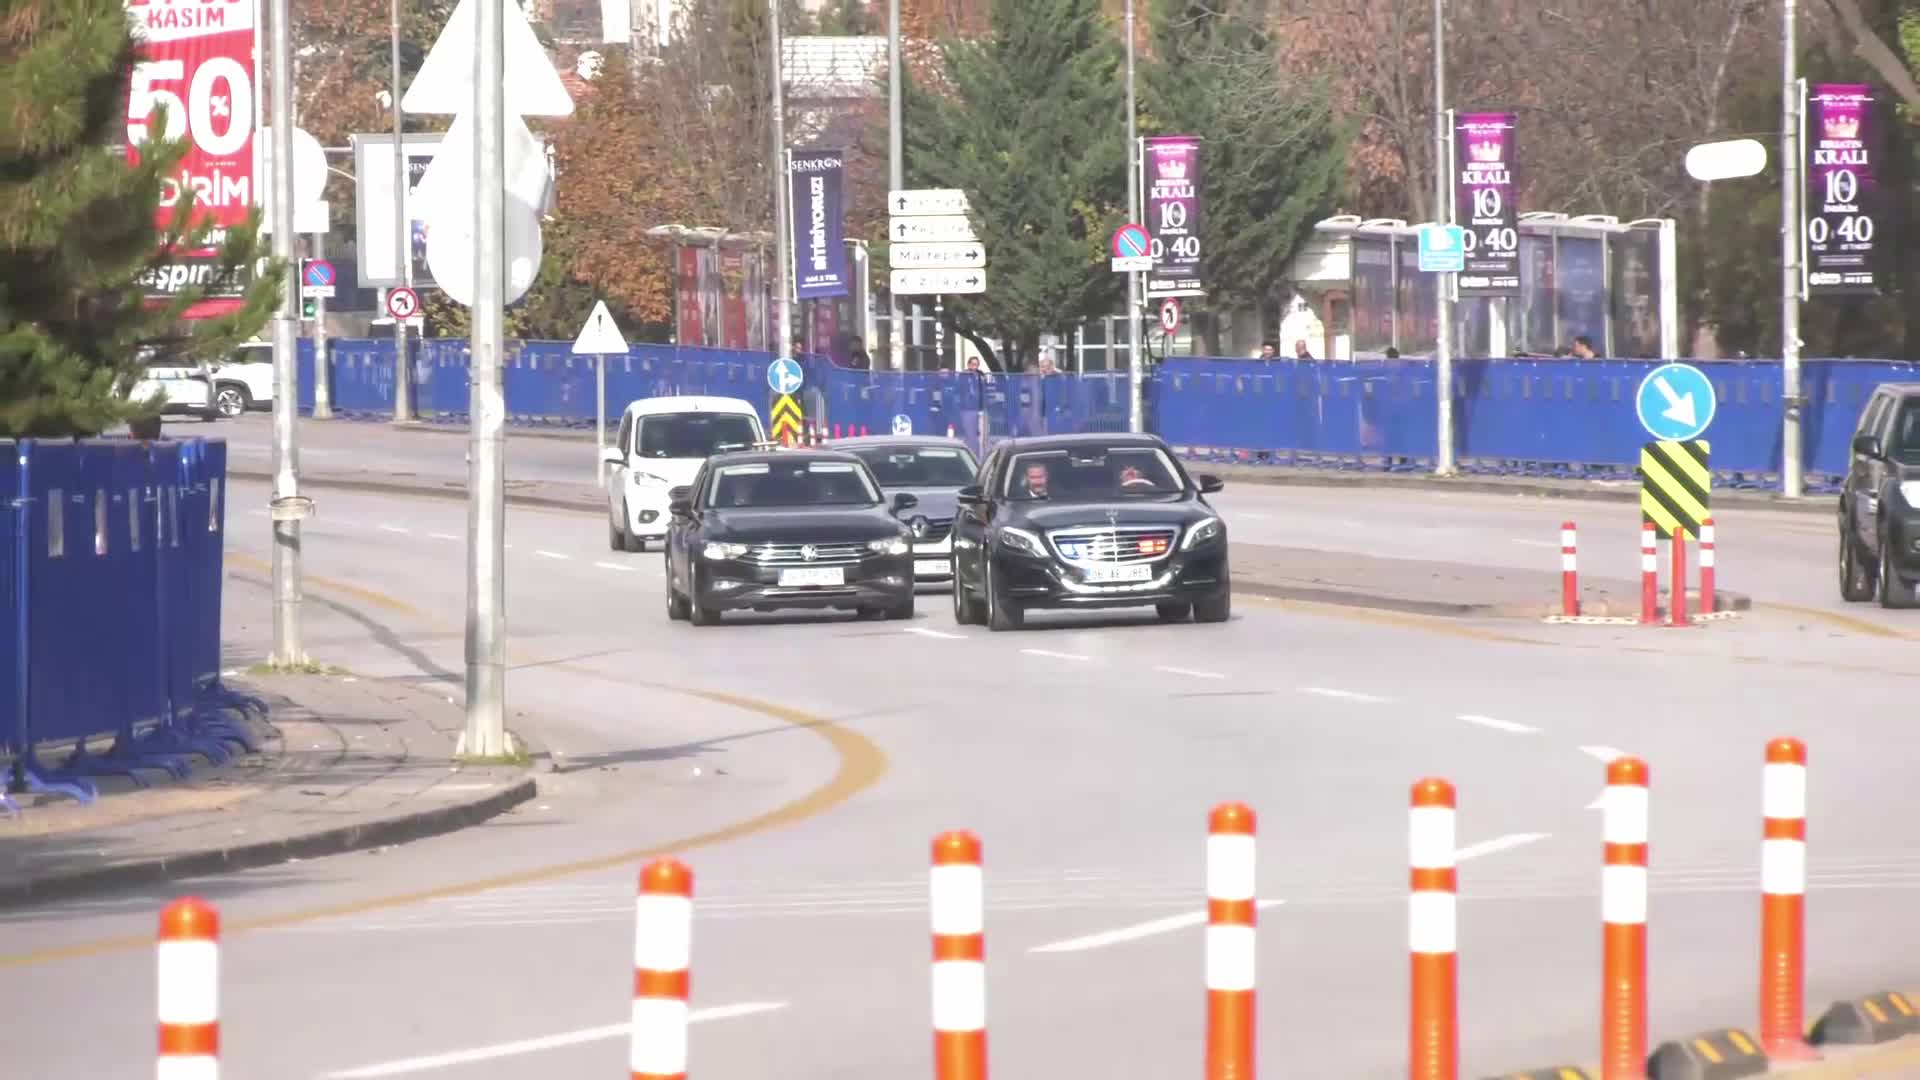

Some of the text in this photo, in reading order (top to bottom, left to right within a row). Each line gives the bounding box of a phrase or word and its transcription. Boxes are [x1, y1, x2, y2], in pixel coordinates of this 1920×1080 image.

[146, 7, 225, 28] KASIM
[127, 57, 252, 156] 50
[1814, 150, 1868, 165] KRALI
[1462, 171, 1511, 185] KRALI
[1825, 169, 1857, 203] 10
[1151, 186, 1195, 199] KRALI
[1472, 188, 1501, 217] 10
[1160, 201, 1187, 228] 10
[1484, 228, 1517, 251] 40
[1837, 215, 1873, 242] 40
[1170, 236, 1200, 257] 40
